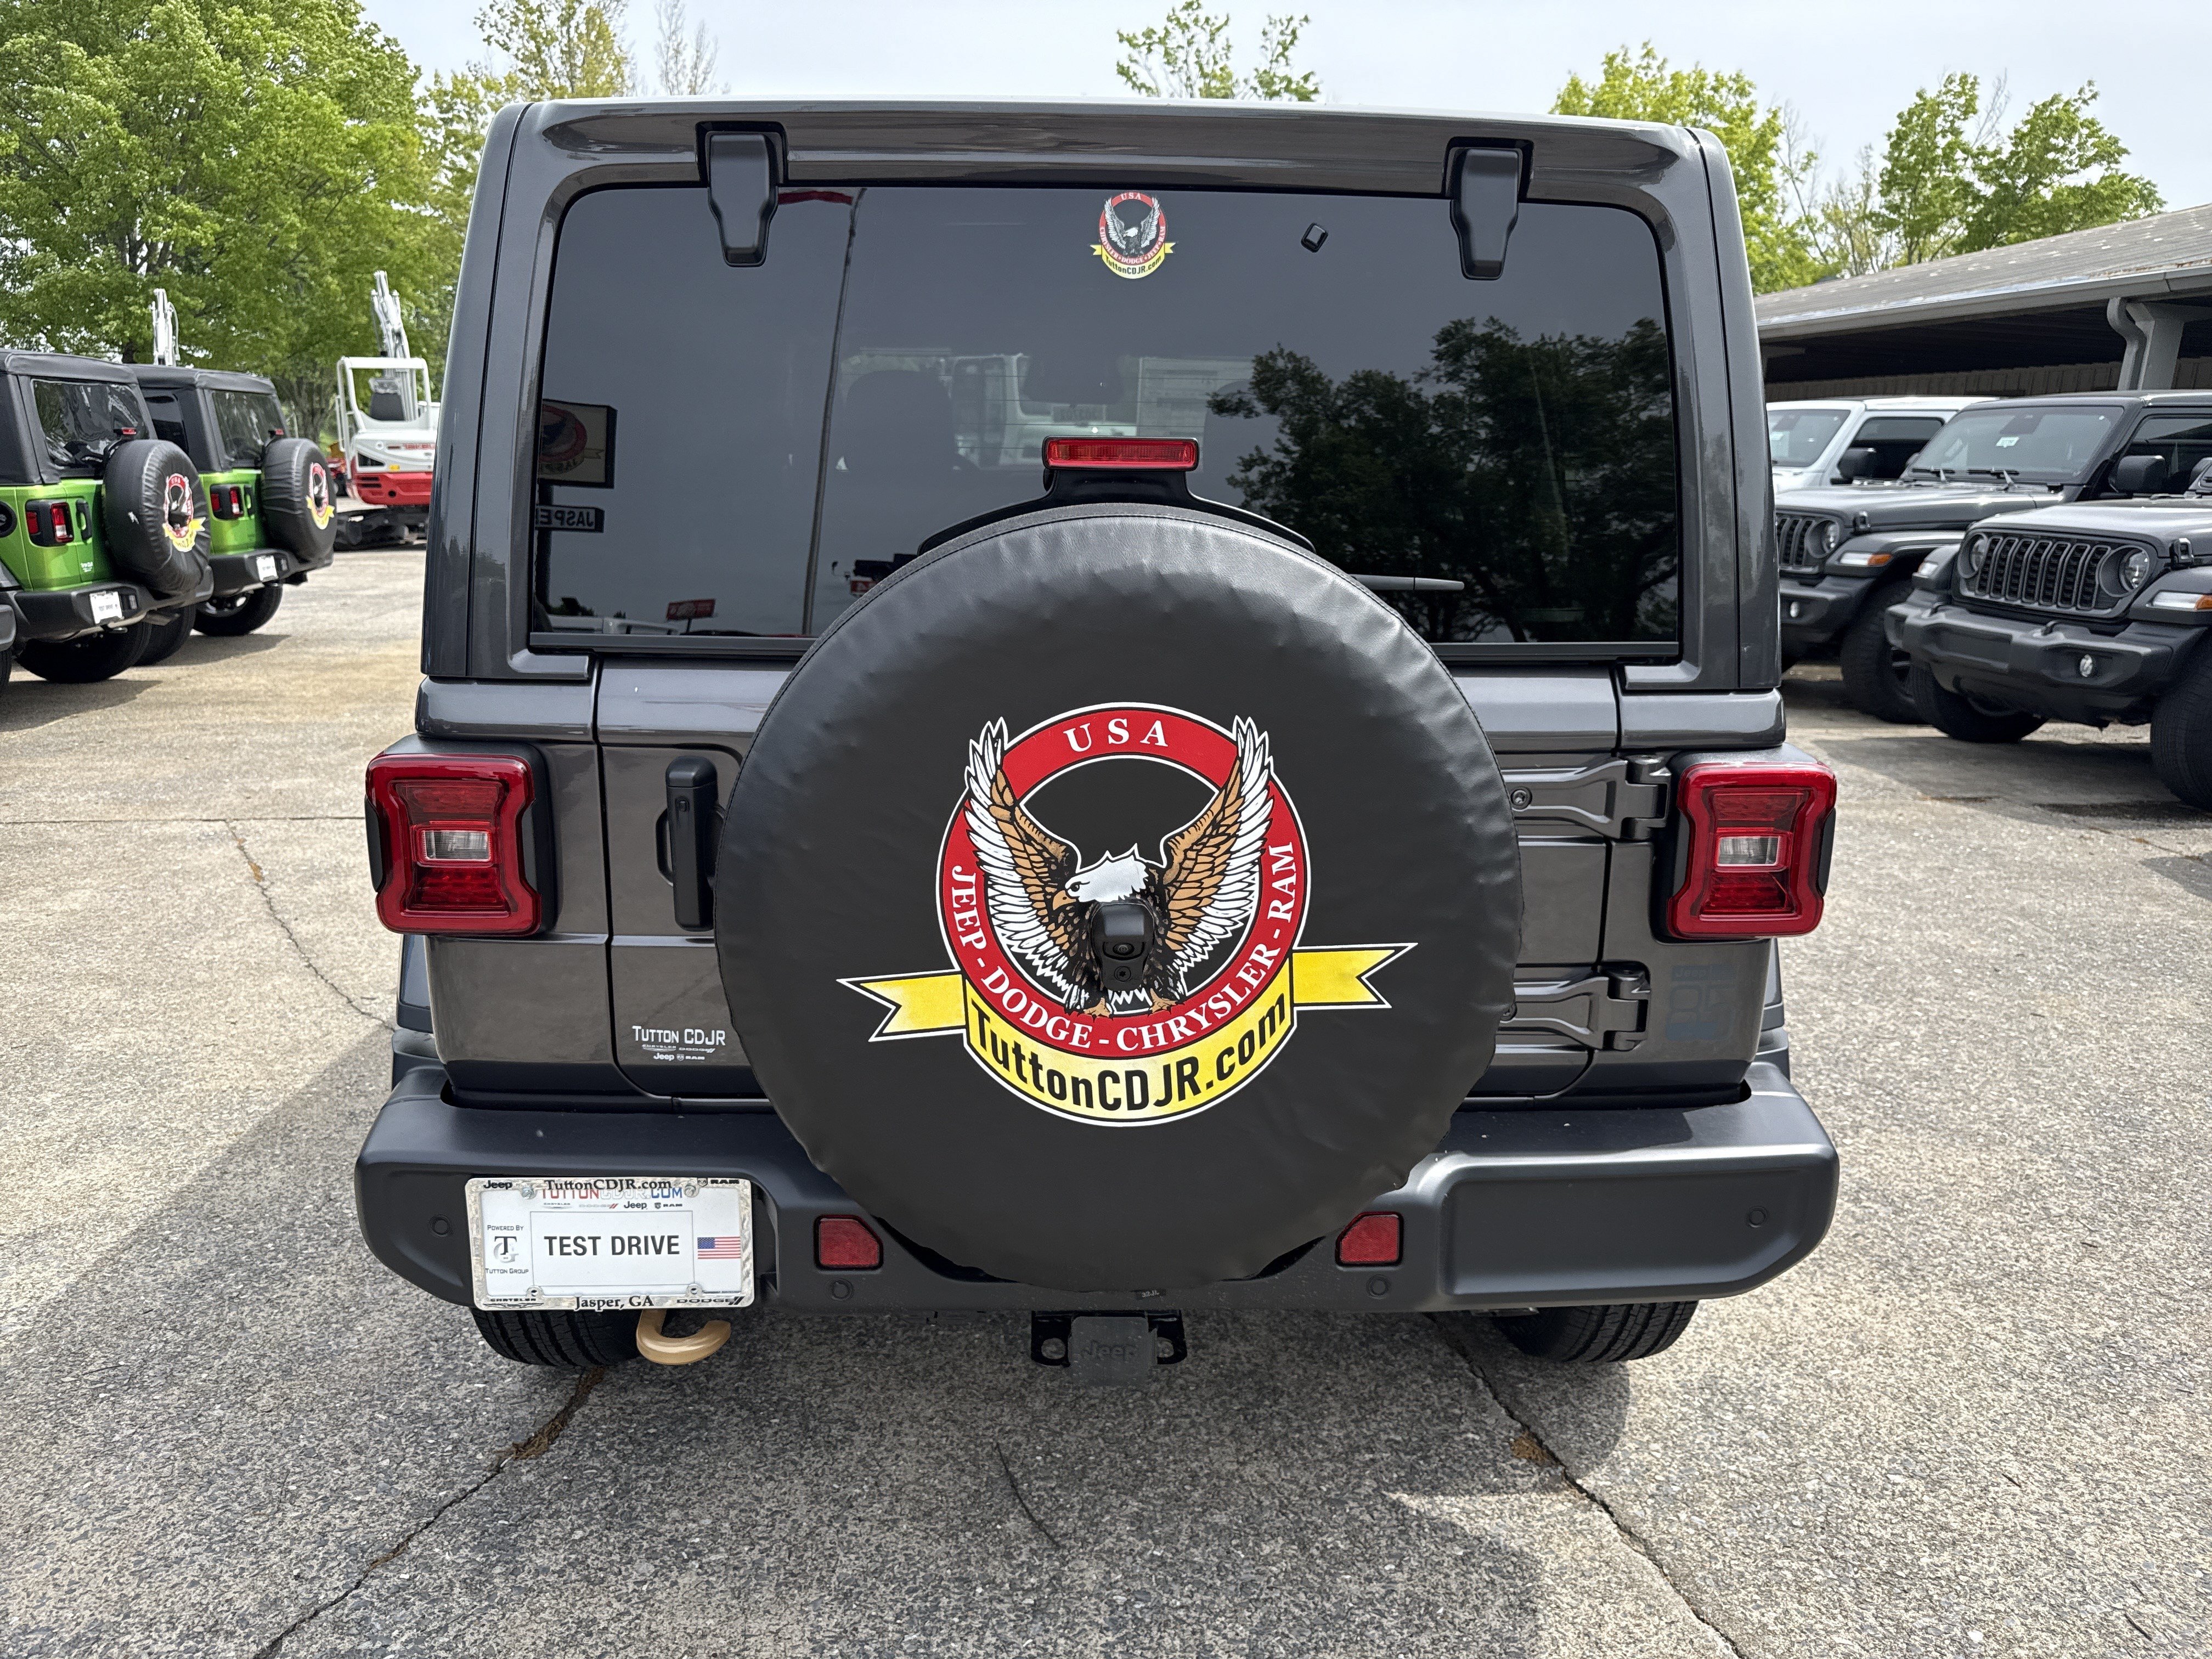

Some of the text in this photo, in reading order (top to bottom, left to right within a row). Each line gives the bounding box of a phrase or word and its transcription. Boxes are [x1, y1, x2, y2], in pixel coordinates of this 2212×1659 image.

[1120, 192, 1142, 200] USA
[1105, 255, 1161, 275] TuttonCDJR.com
[1063, 718, 1169, 752] USA
[951, 842, 1297, 1051] JEEP DODGE CHRYSLER RAM
[684, 1028, 726, 1046] CDJR
[653, 1052, 675, 1061] Jeep
[970, 992, 1285, 1111] TuttonCDJR.com
[483, 1180, 513, 1190] Jeep
[544, 1178, 673, 1192] TuttonCDJR.com
[623, 1201, 647, 1209] Jeep
[544, 1235, 680, 1256] TEST DRIVE
[574, 1296, 625, 1311] Jasper,
[628, 1295, 654, 1307] GA
